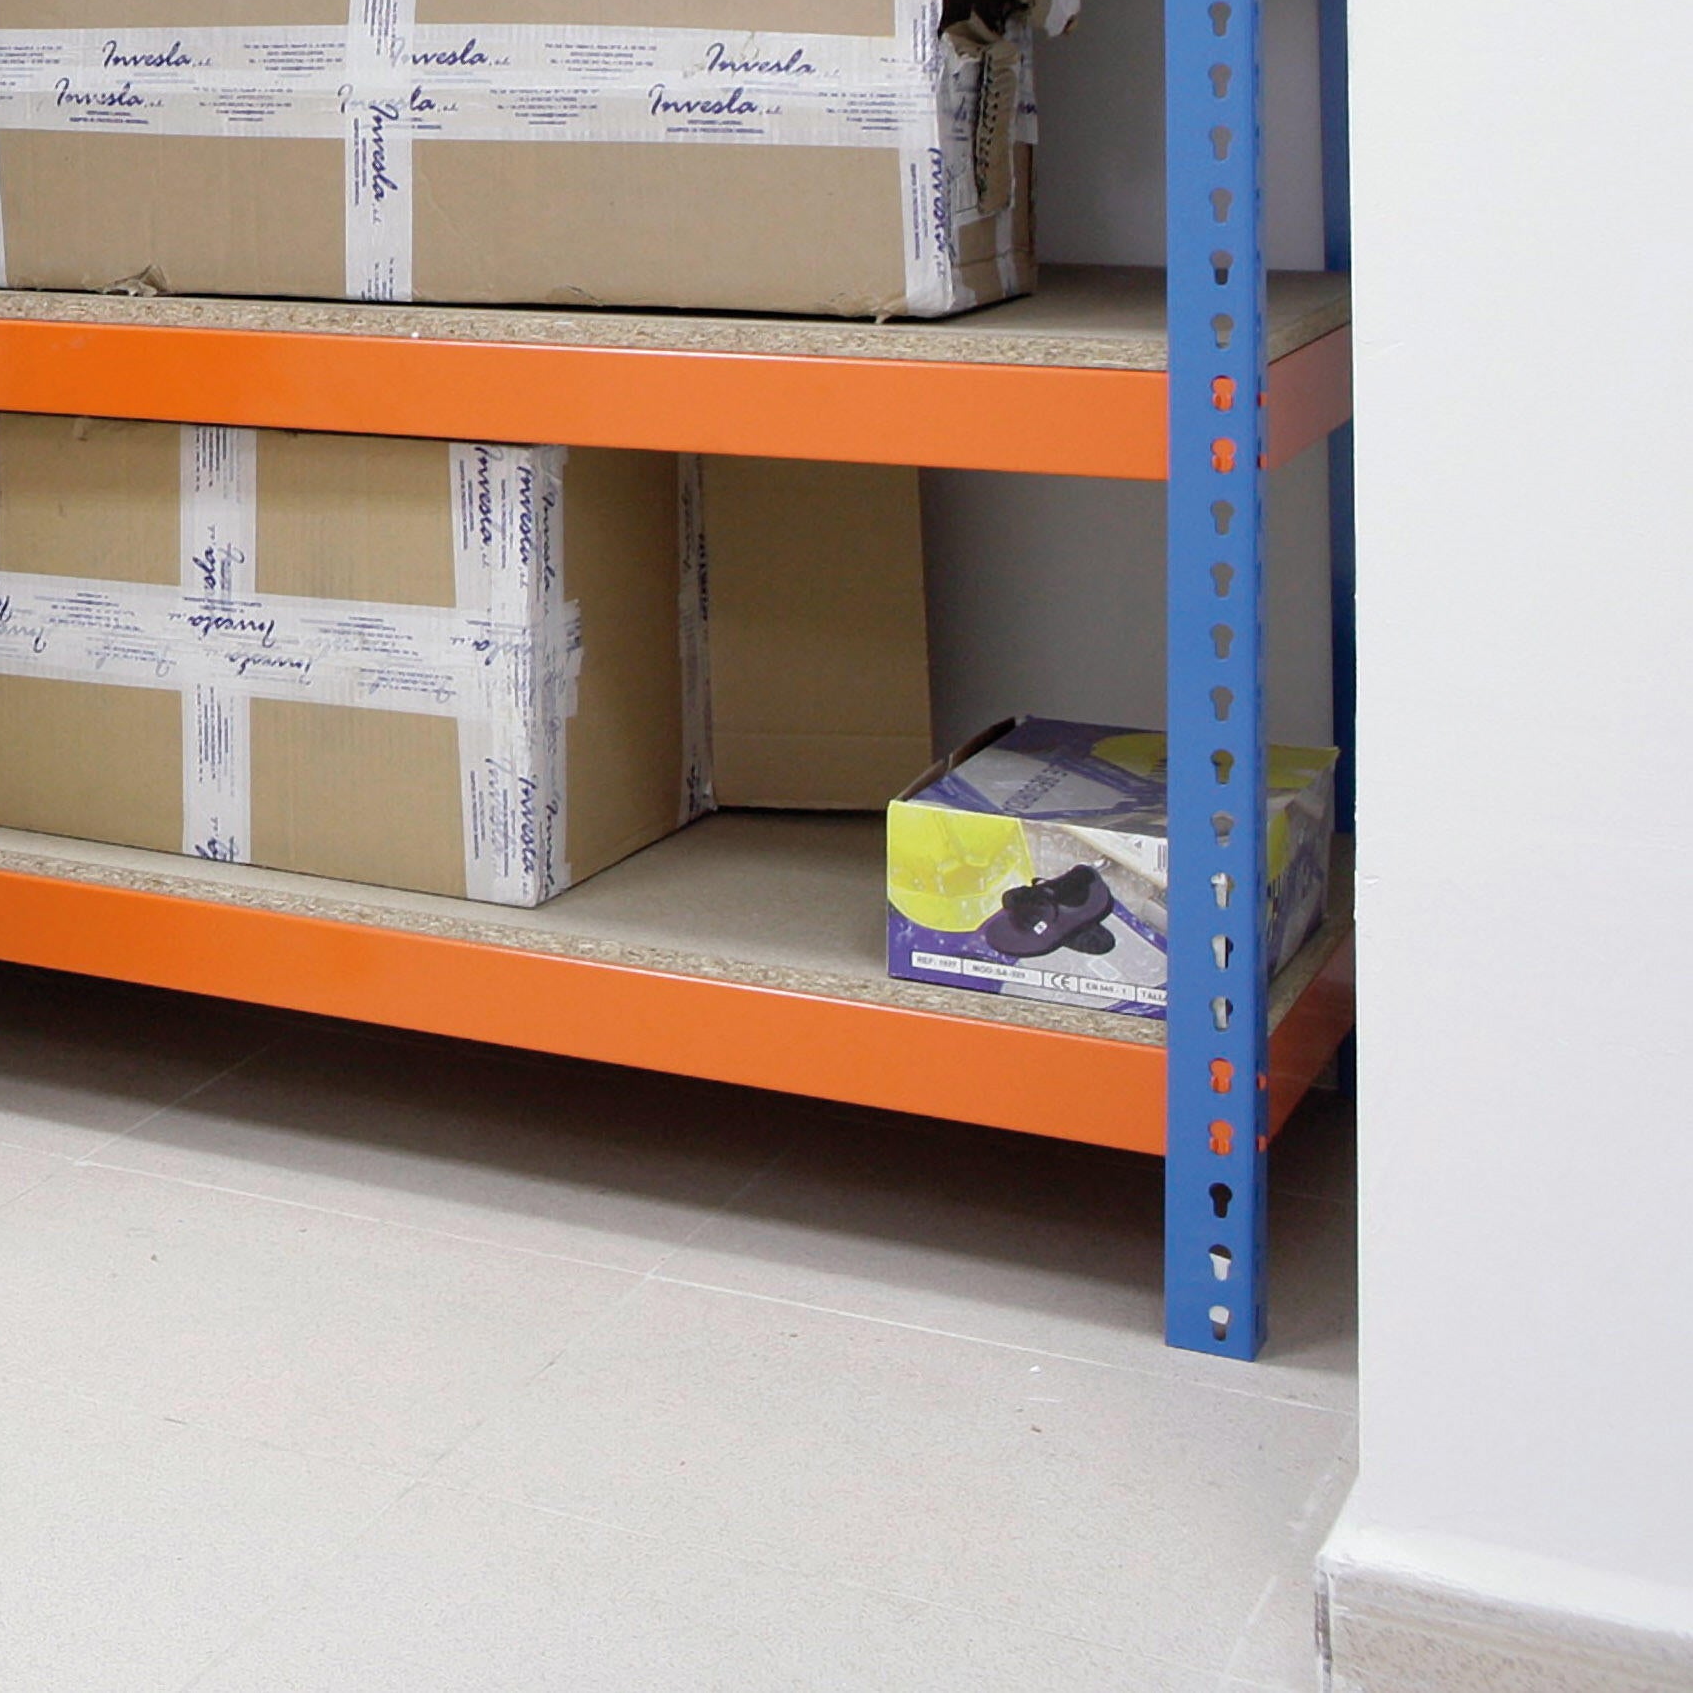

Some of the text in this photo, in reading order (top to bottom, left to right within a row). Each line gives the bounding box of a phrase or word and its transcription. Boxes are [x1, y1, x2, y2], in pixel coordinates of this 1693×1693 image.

[102, 40, 191, 68] Invesla
[706, 42, 815, 74] Invesla
[55, 77, 143, 106] Invesla
[648, 83, 757, 116] Invesla
[369, 104, 399, 202] Invesla
[474, 446, 505, 546] Invesla
[186, 611, 277, 647] Invesla
